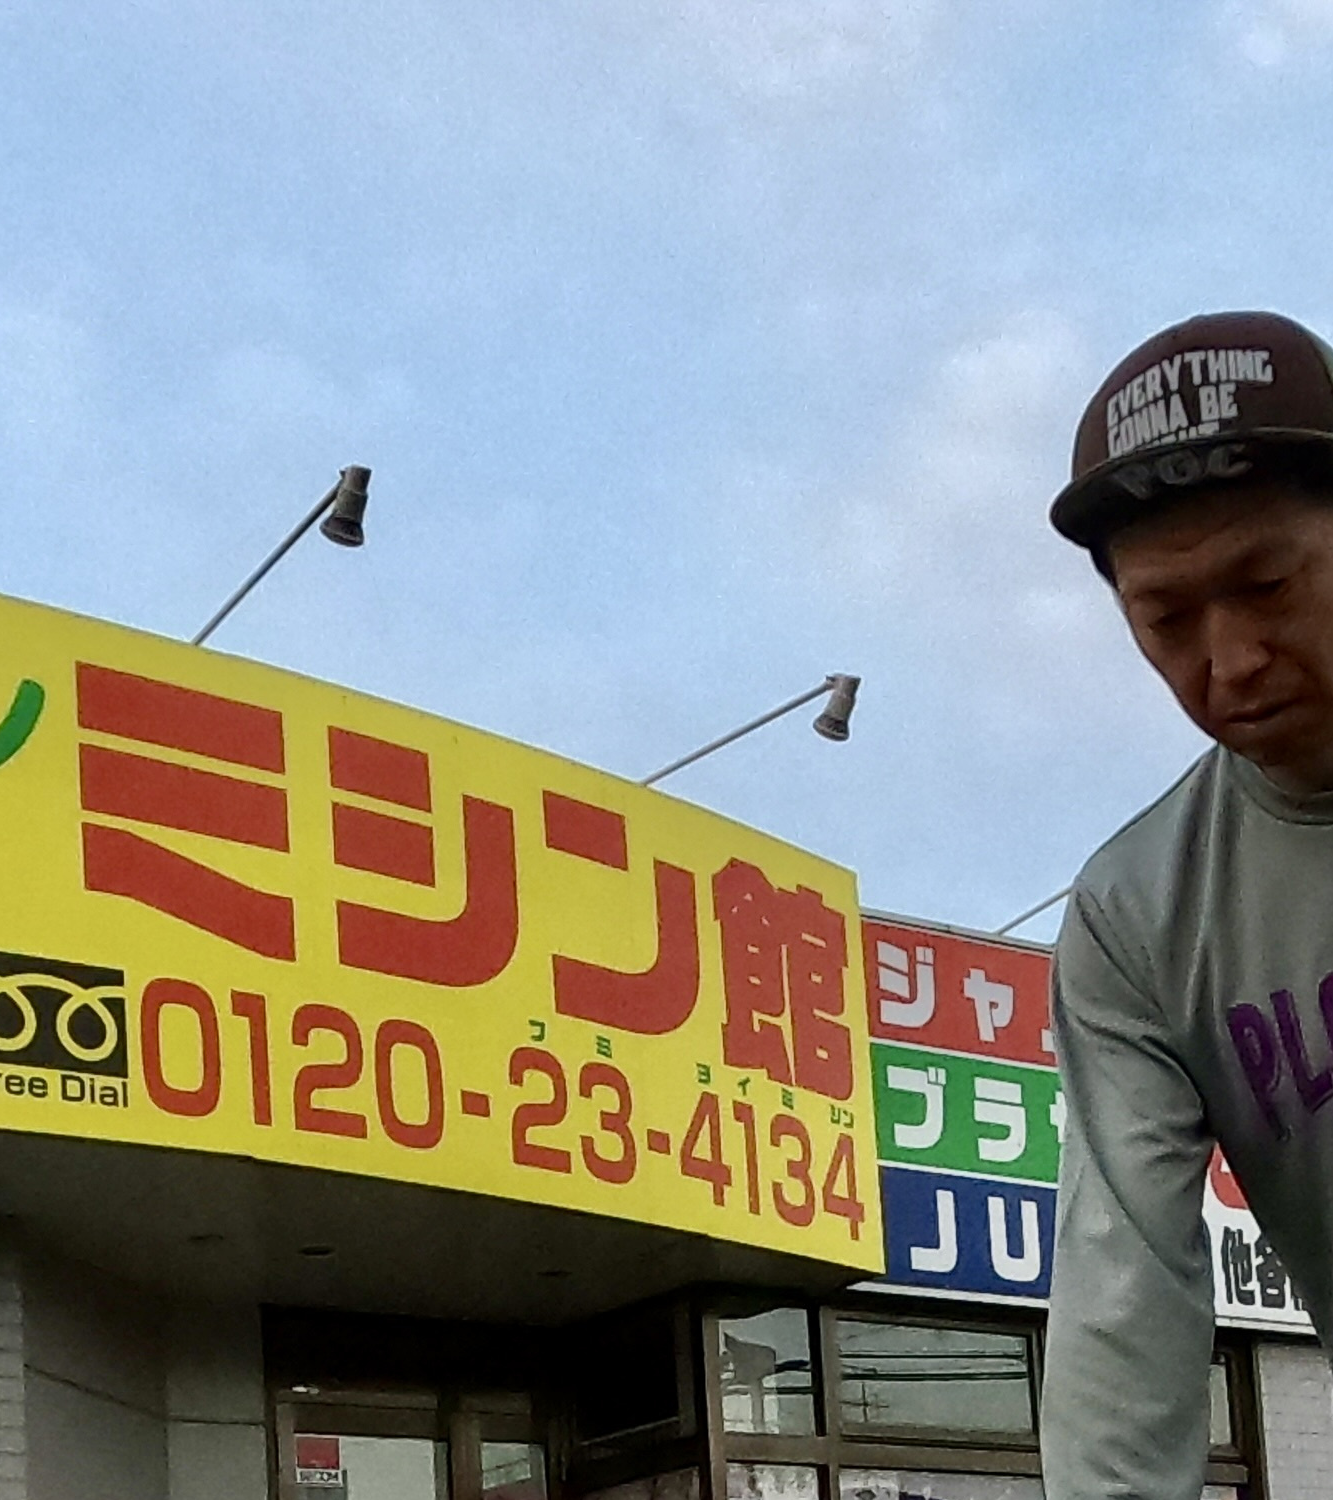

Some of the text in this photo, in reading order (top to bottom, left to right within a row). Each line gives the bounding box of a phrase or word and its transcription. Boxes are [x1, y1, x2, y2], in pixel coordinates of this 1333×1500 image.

[1106, 349, 1273, 427] EVERYTHING
[1107, 393, 1190, 460] GONNA
[1198, 382, 1238, 422] BE
[76, 661, 855, 1101] ミシン館
[876, 940, 1056, 1053] ジャ
[60, 1070, 130, 1109] Dial
[140, 977, 865, 1242] 0120-23-4134
[886, 1066, 1064, 1163] ブラ
[910, 1189, 1041, 1283] JU
